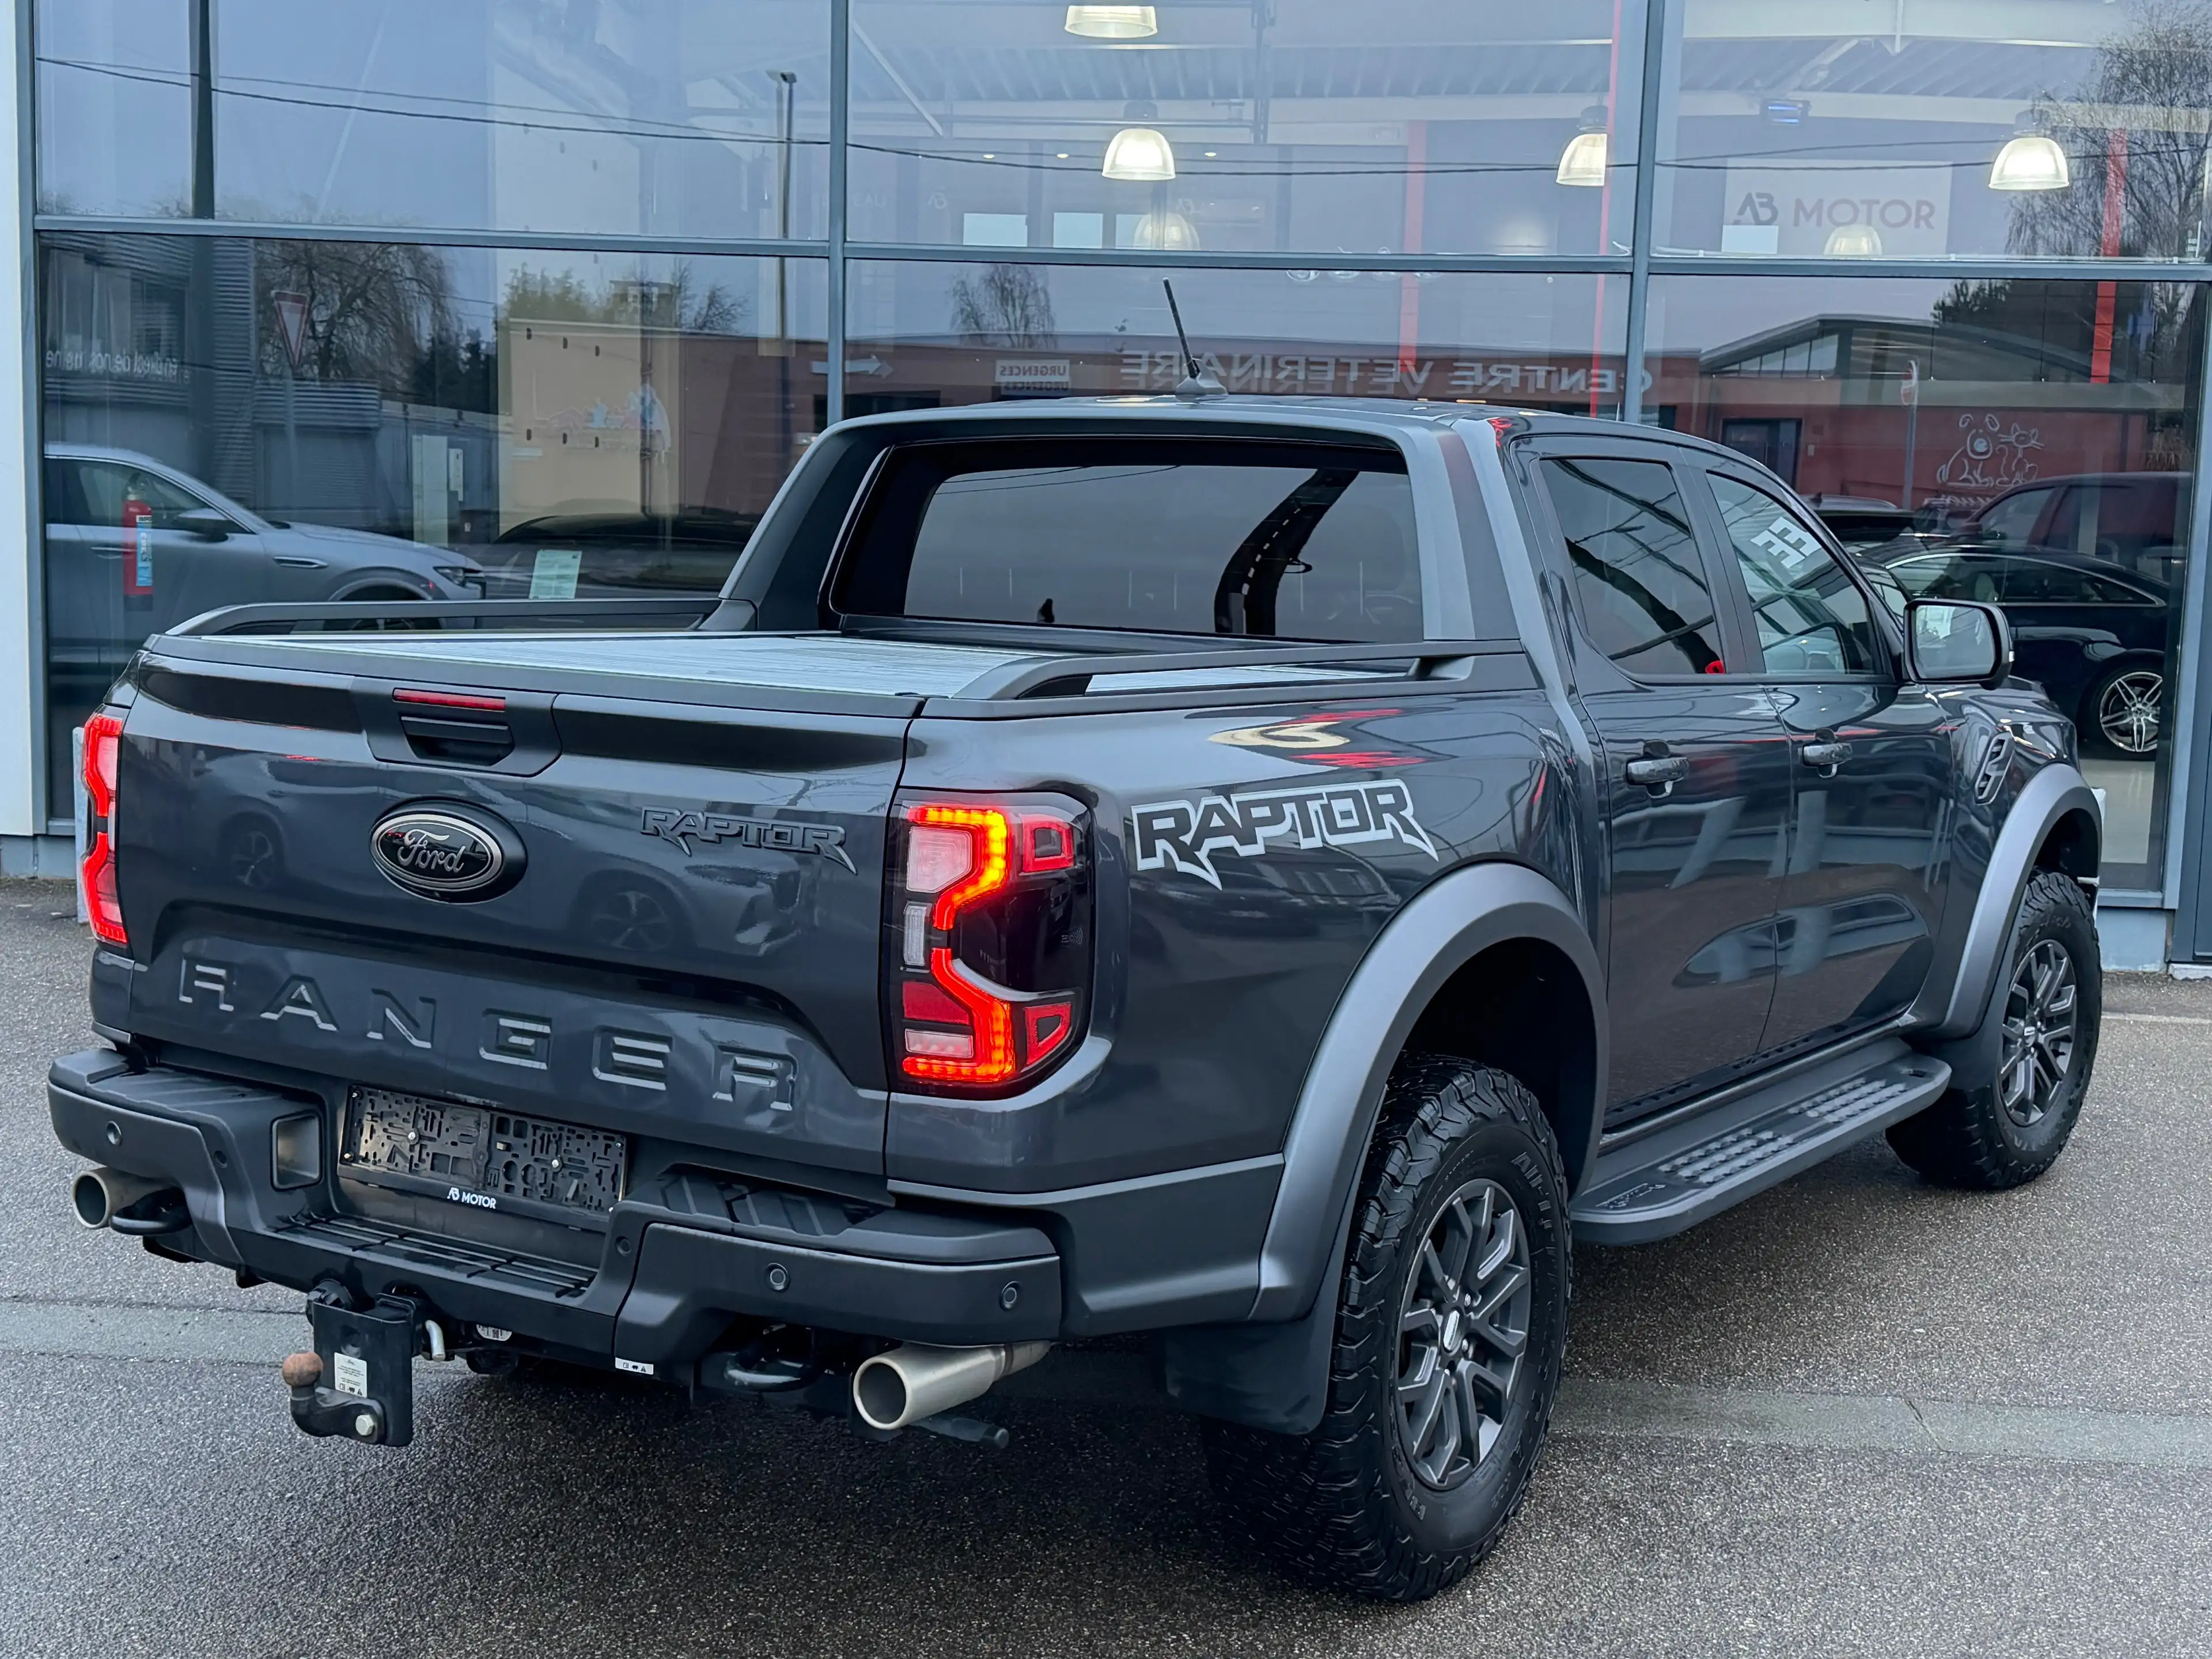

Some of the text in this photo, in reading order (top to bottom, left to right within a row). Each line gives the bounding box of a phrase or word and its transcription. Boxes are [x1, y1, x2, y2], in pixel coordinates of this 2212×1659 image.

[1794, 198, 1936, 229] MOTOR
[397, 828, 465, 873] Ford
[641, 805, 858, 876] RAPTOR
[1131, 778, 1439, 891] RAPTOR
[177, 956, 799, 1113] RANGER
[461, 1191, 497, 1209] MOTOR
